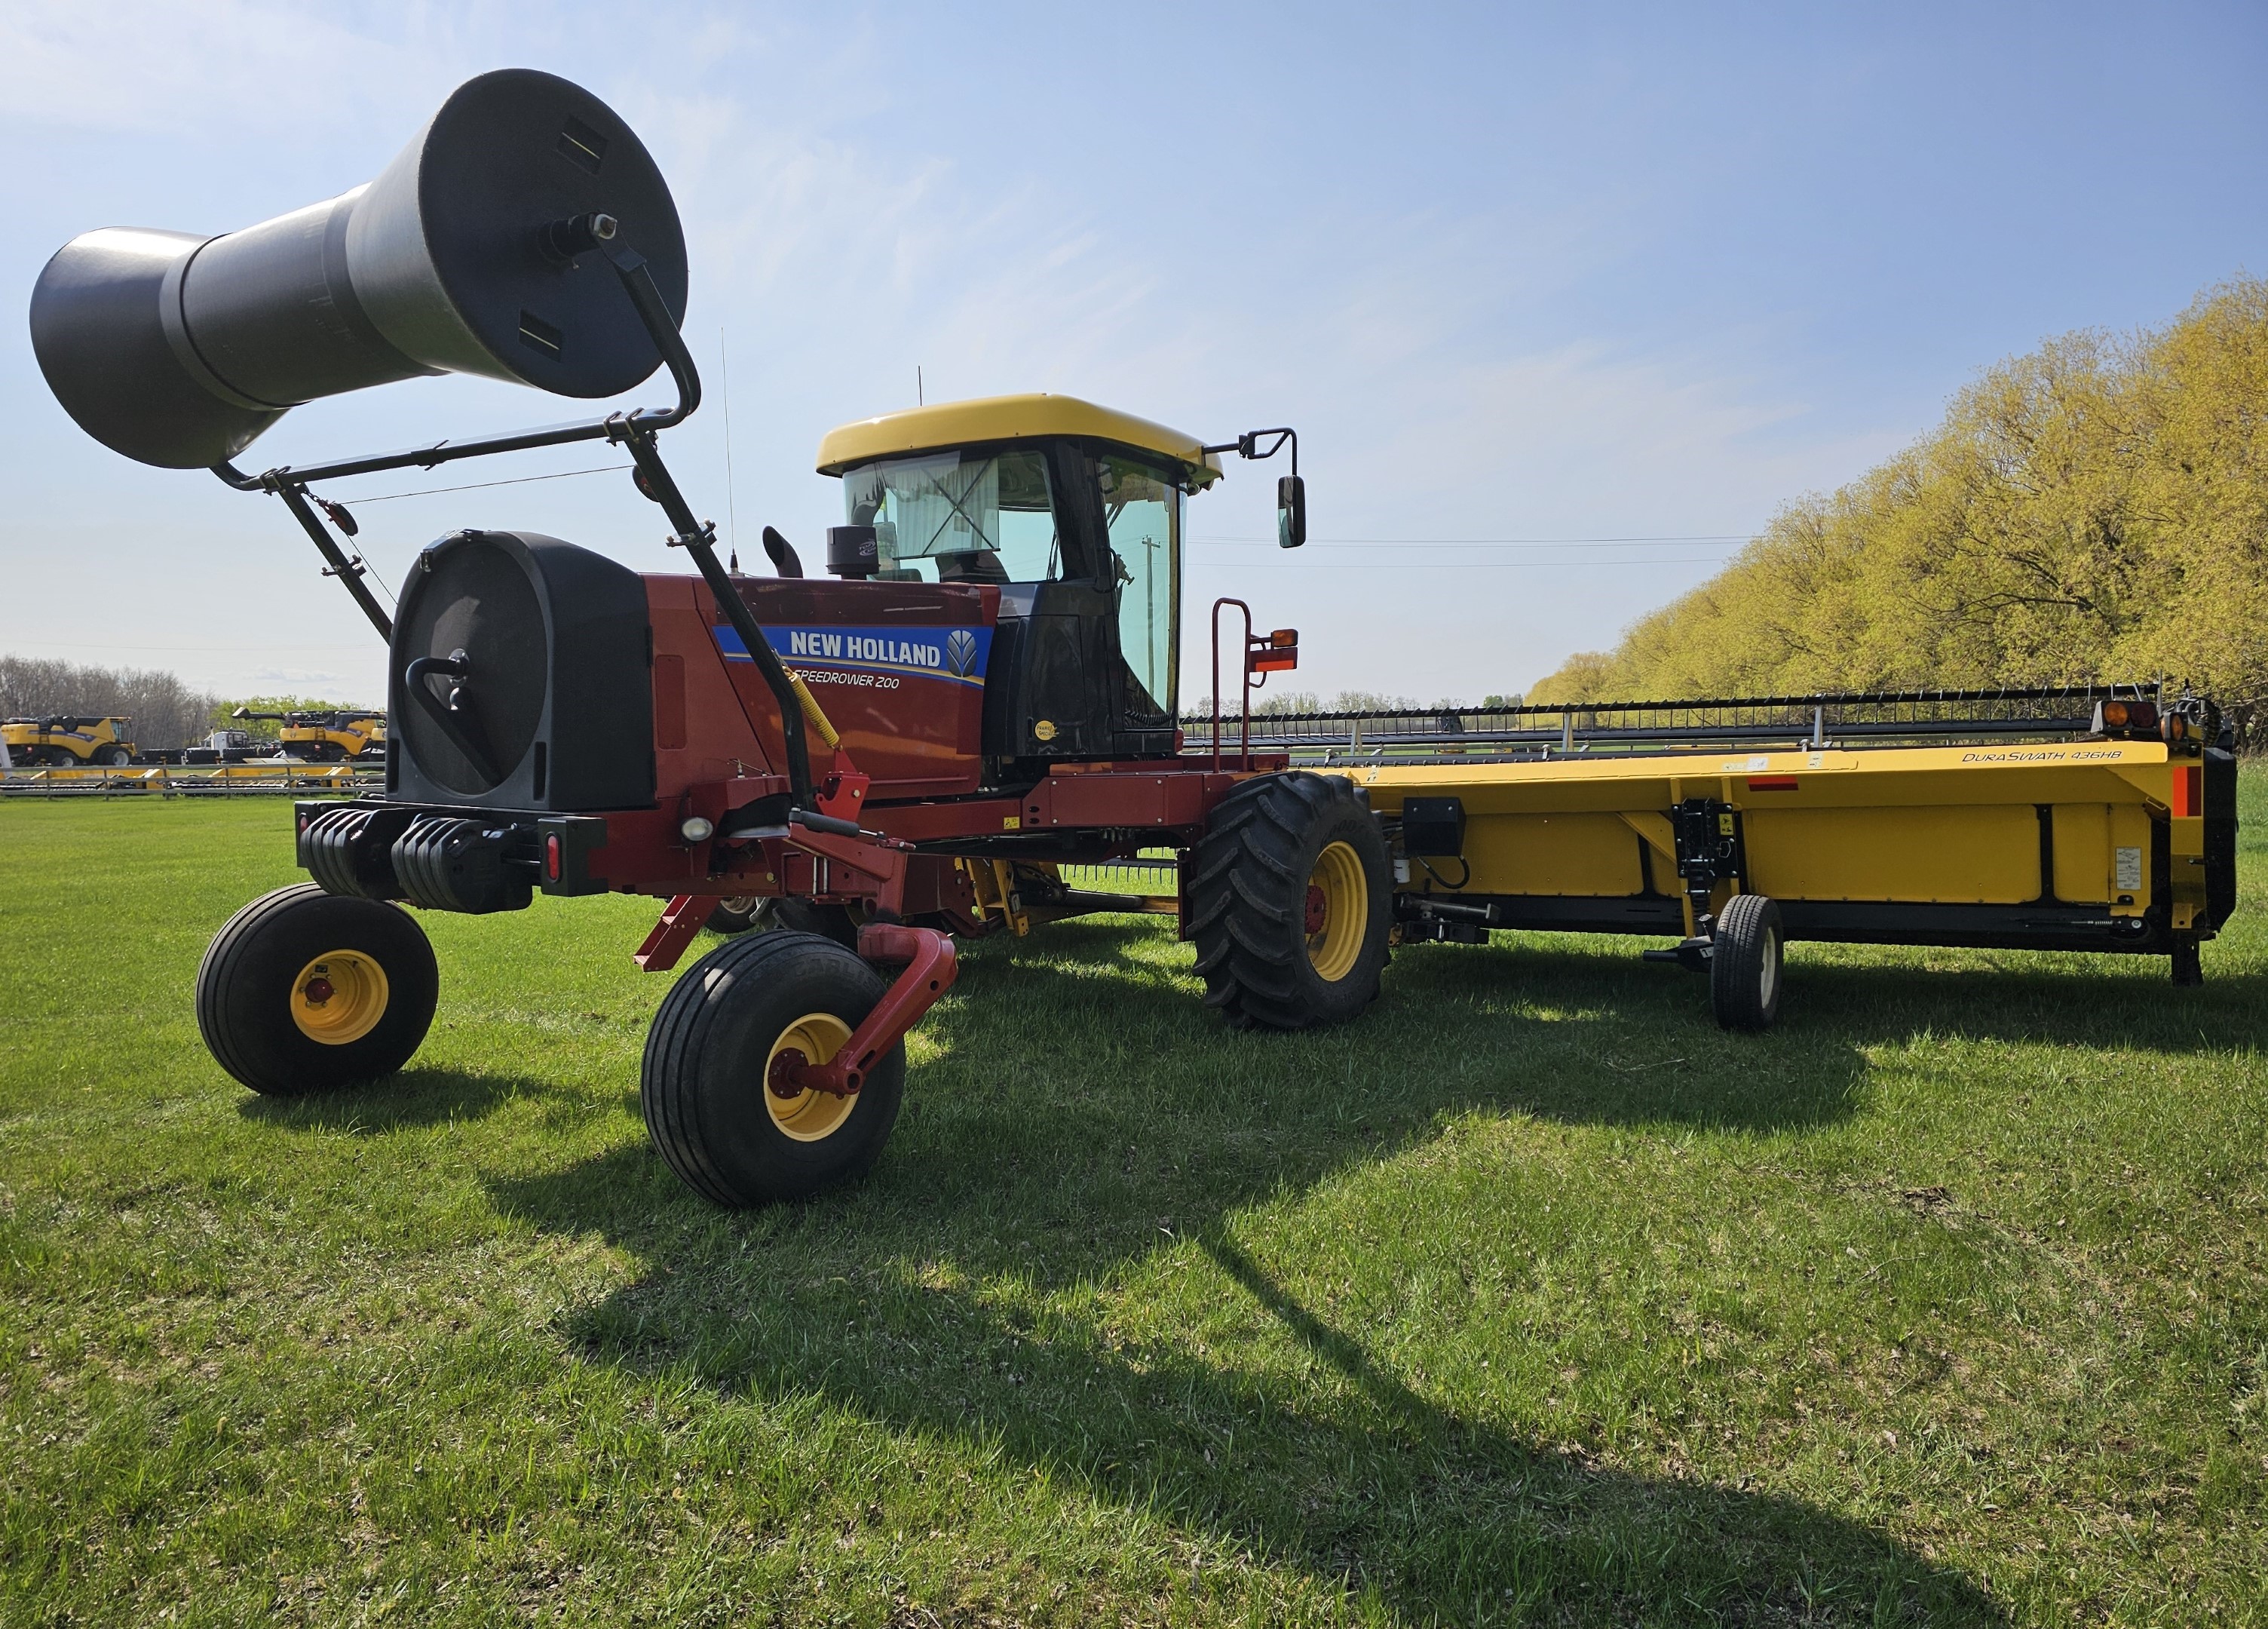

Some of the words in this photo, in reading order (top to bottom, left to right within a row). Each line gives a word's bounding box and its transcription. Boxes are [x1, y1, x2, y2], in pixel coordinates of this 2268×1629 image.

[791, 631, 841, 657] NEW
[847, 636, 941, 667] HOLLAND
[793, 669, 875, 686] SPEEDROWER
[875, 676, 900, 689] 200
